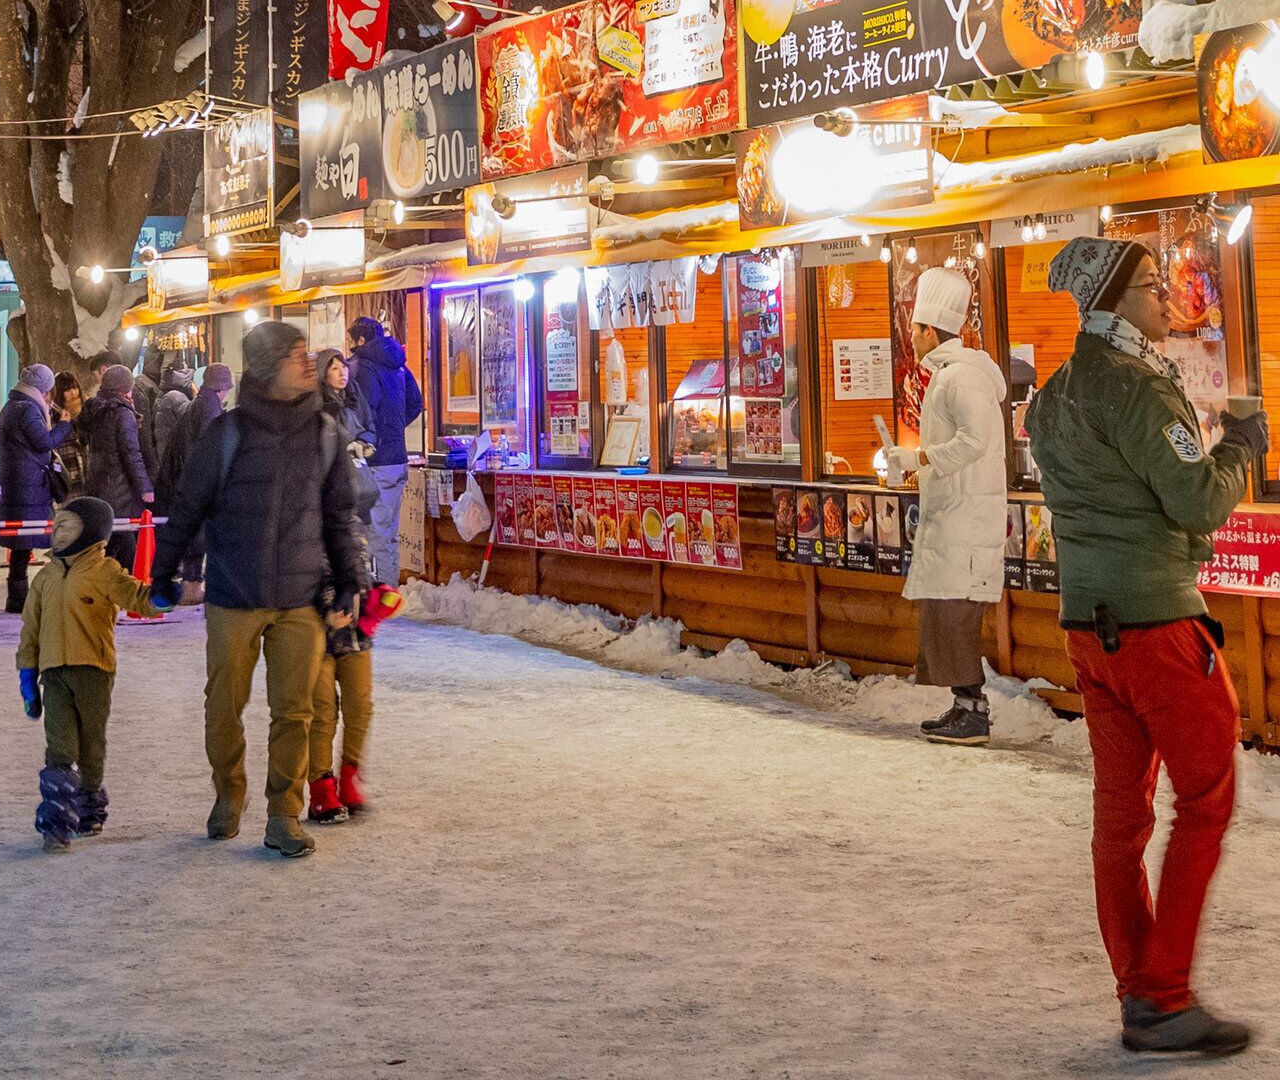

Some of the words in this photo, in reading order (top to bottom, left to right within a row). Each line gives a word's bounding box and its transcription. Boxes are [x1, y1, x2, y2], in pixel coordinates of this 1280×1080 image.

[383, 49, 473, 117] 味噌らーめん
[757, 46, 950, 109] こだわった本格Curry
[424, 129, 478, 186] 500円
